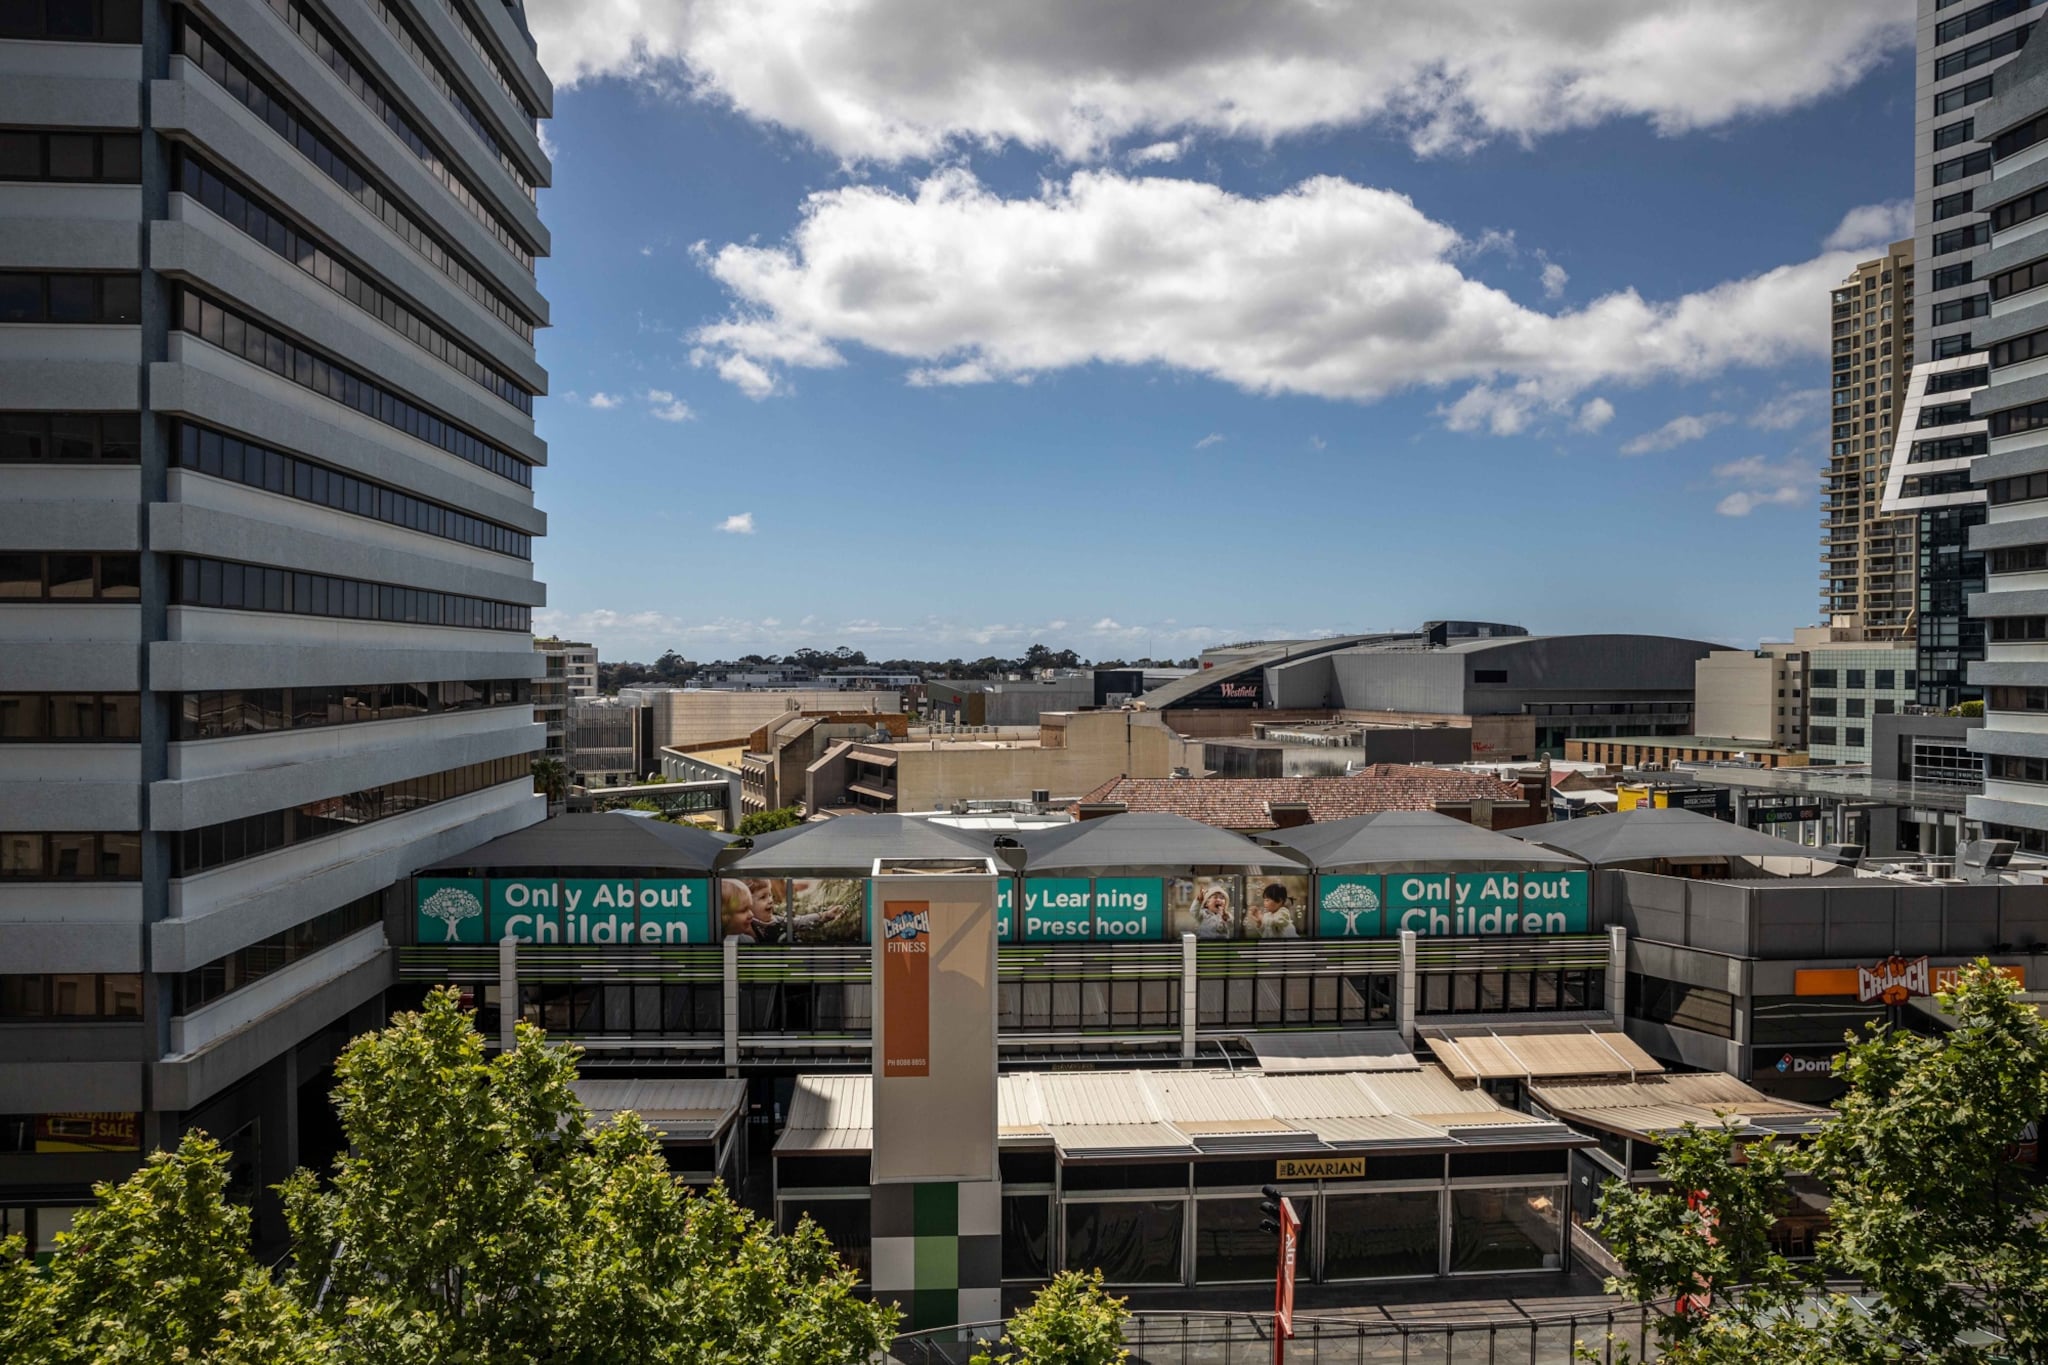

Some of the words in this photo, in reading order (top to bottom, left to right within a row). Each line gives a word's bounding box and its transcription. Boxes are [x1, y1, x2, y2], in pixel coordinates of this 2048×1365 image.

[1220, 683, 1257, 698] Westfield
[505, 883, 582, 912] Only
[593, 883, 692, 907] About
[998, 889, 1037, 911] rly
[1043, 889, 1148, 911] Learning
[1402, 877, 1471, 904] Only
[1480, 877, 1570, 899] About
[505, 914, 688, 943] Children
[884, 911, 930, 939] CRUNCH
[1027, 916, 1147, 935] Preschool
[1401, 906, 1566, 936] Children
[888, 941, 926, 953] FITNESS
[1859, 958, 1929, 1002] CRUNCH
[98, 1122, 135, 1137] SALE
[1287, 1161, 1362, 1176] BAVARIAN
